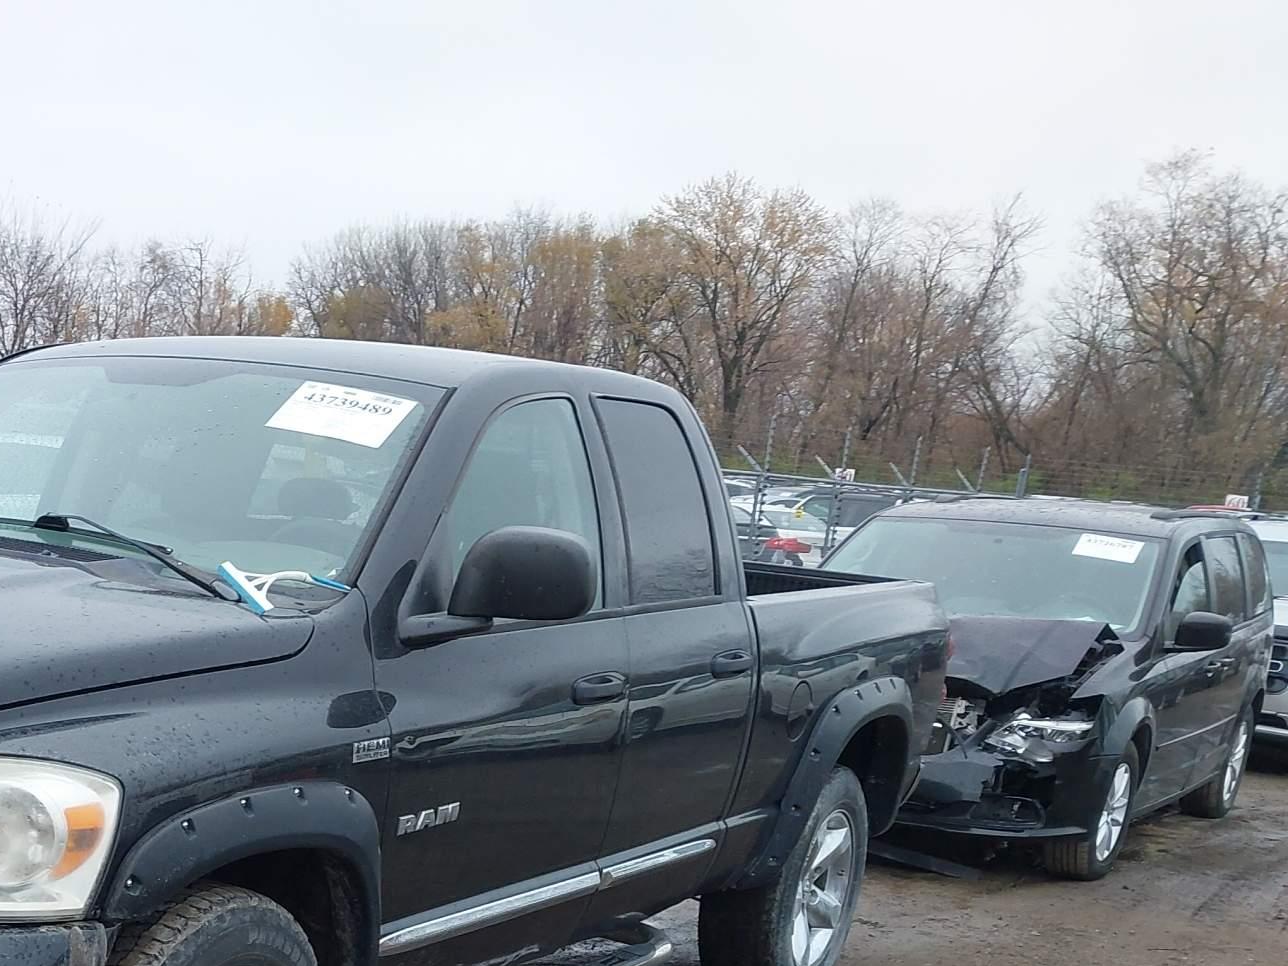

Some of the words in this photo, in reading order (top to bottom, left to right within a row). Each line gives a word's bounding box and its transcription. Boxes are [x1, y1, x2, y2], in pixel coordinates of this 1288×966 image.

[304, 392, 393, 416] 43739489
[355, 739, 390, 754] HEMI
[397, 802, 461, 836] RAM
